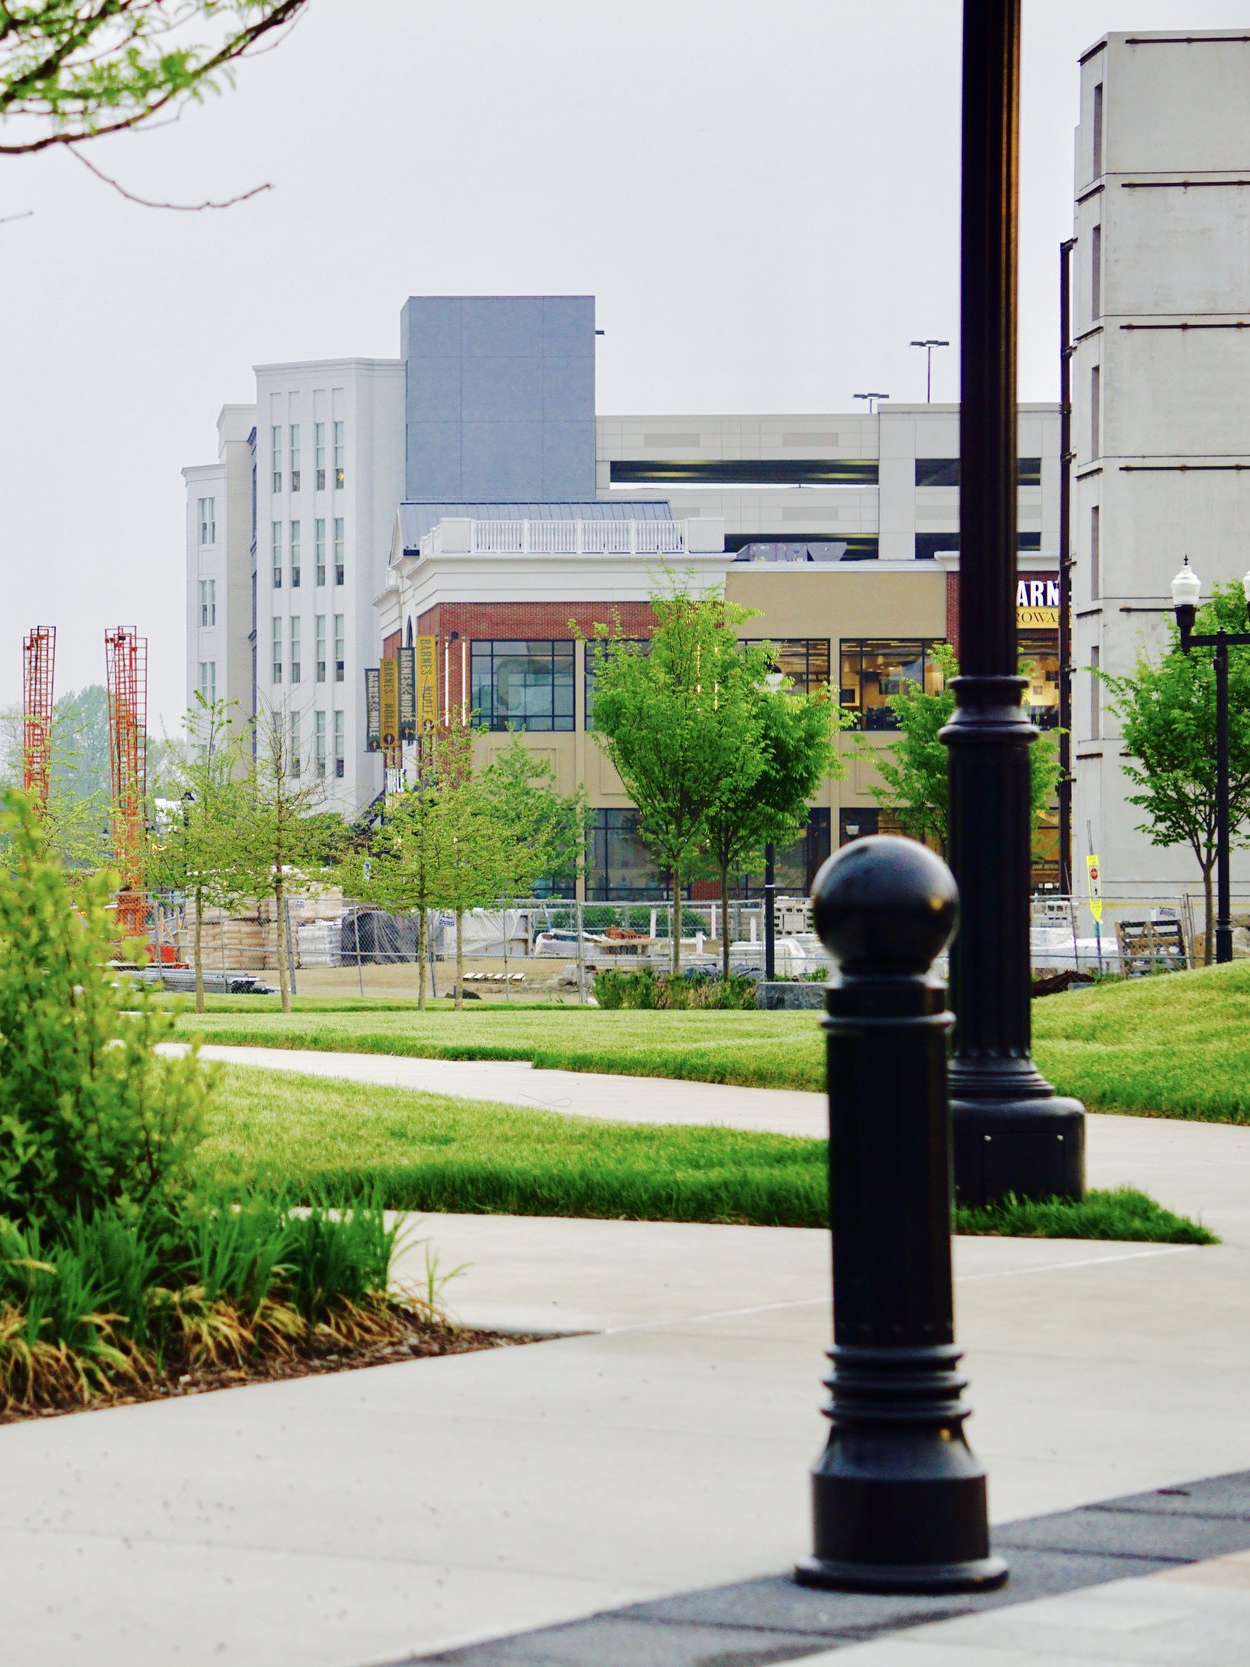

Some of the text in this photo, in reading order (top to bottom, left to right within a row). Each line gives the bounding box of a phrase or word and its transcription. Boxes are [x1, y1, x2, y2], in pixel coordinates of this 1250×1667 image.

[1015, 580, 1060, 607] ARN
[1016, 611, 1057, 624] ROWA
[420, 639, 433, 676] BARNES
[383, 661, 395, 731] BARNES NOBLE
